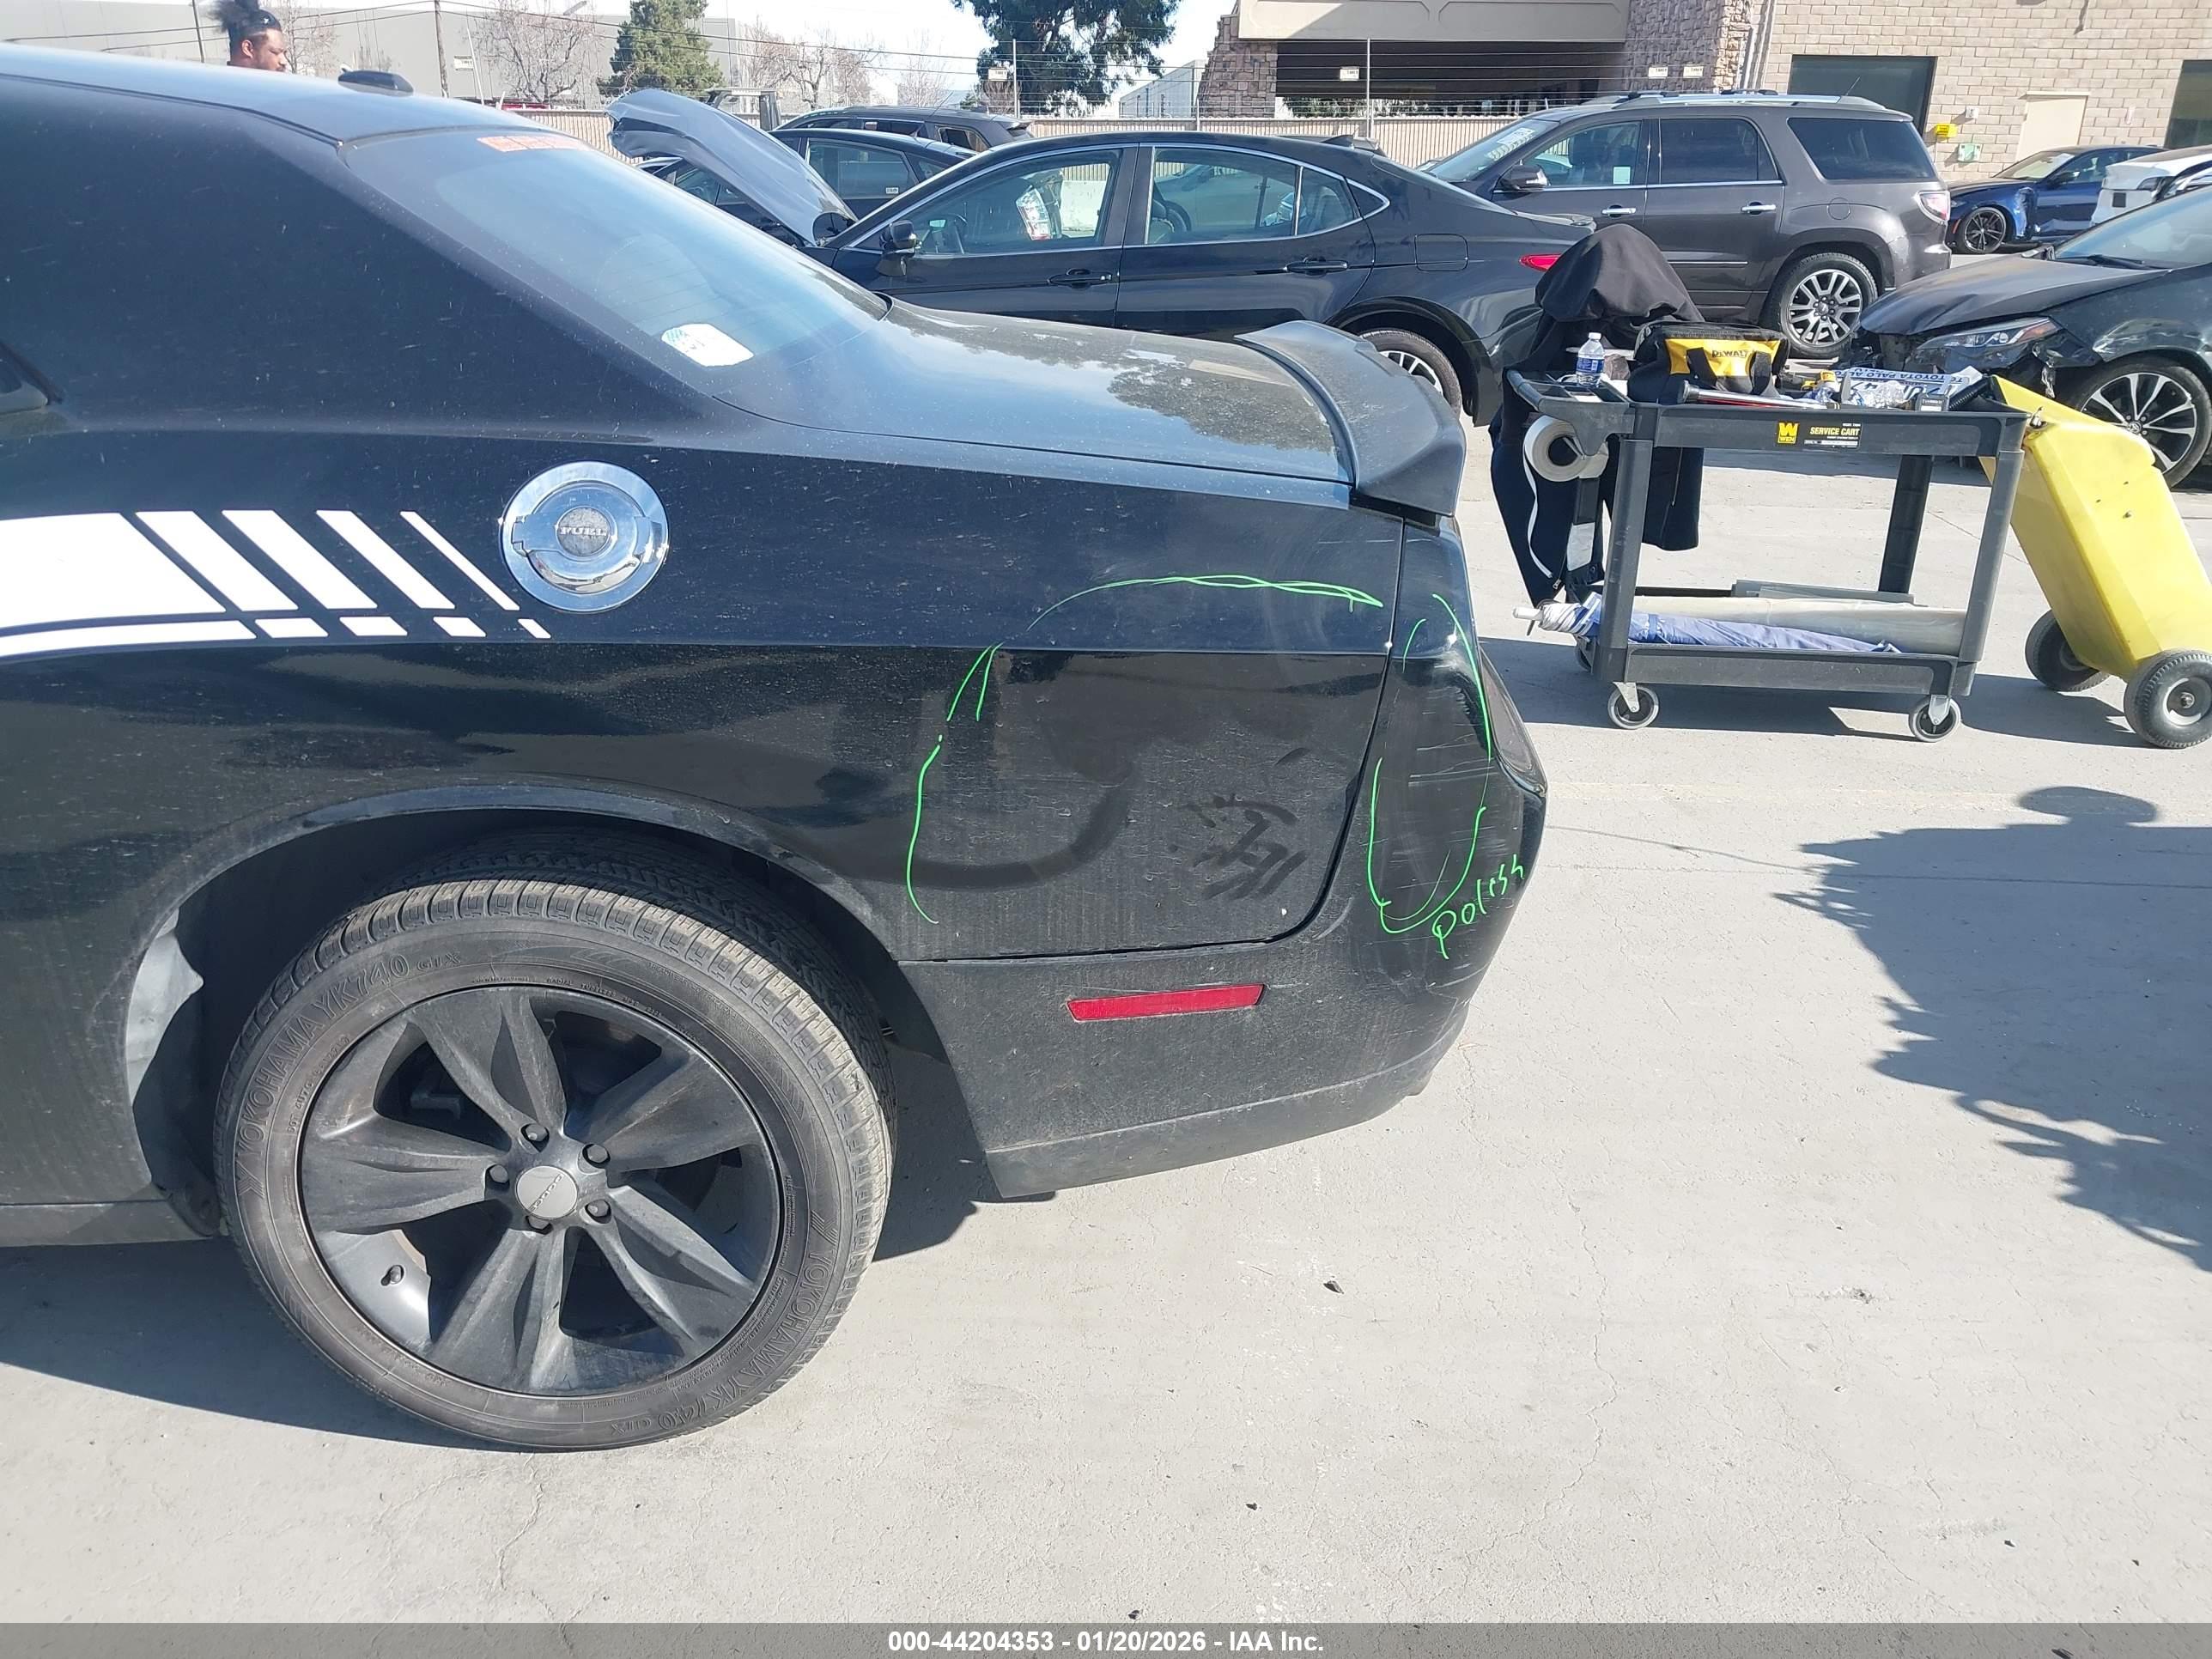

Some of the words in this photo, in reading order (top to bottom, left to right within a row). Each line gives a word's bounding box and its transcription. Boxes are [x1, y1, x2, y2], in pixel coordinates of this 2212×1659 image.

[1869, 370, 1897, 379] PALO
[1809, 427, 1840, 435] SERVICE
[1840, 428, 1861, 436] CART
[560, 526, 607, 537] FUEL
[234, 1014, 325, 1158] YOKOHAMA
[312, 953, 410, 1021] YK740
[740, 1249, 833, 1376] YOKOHAMA
